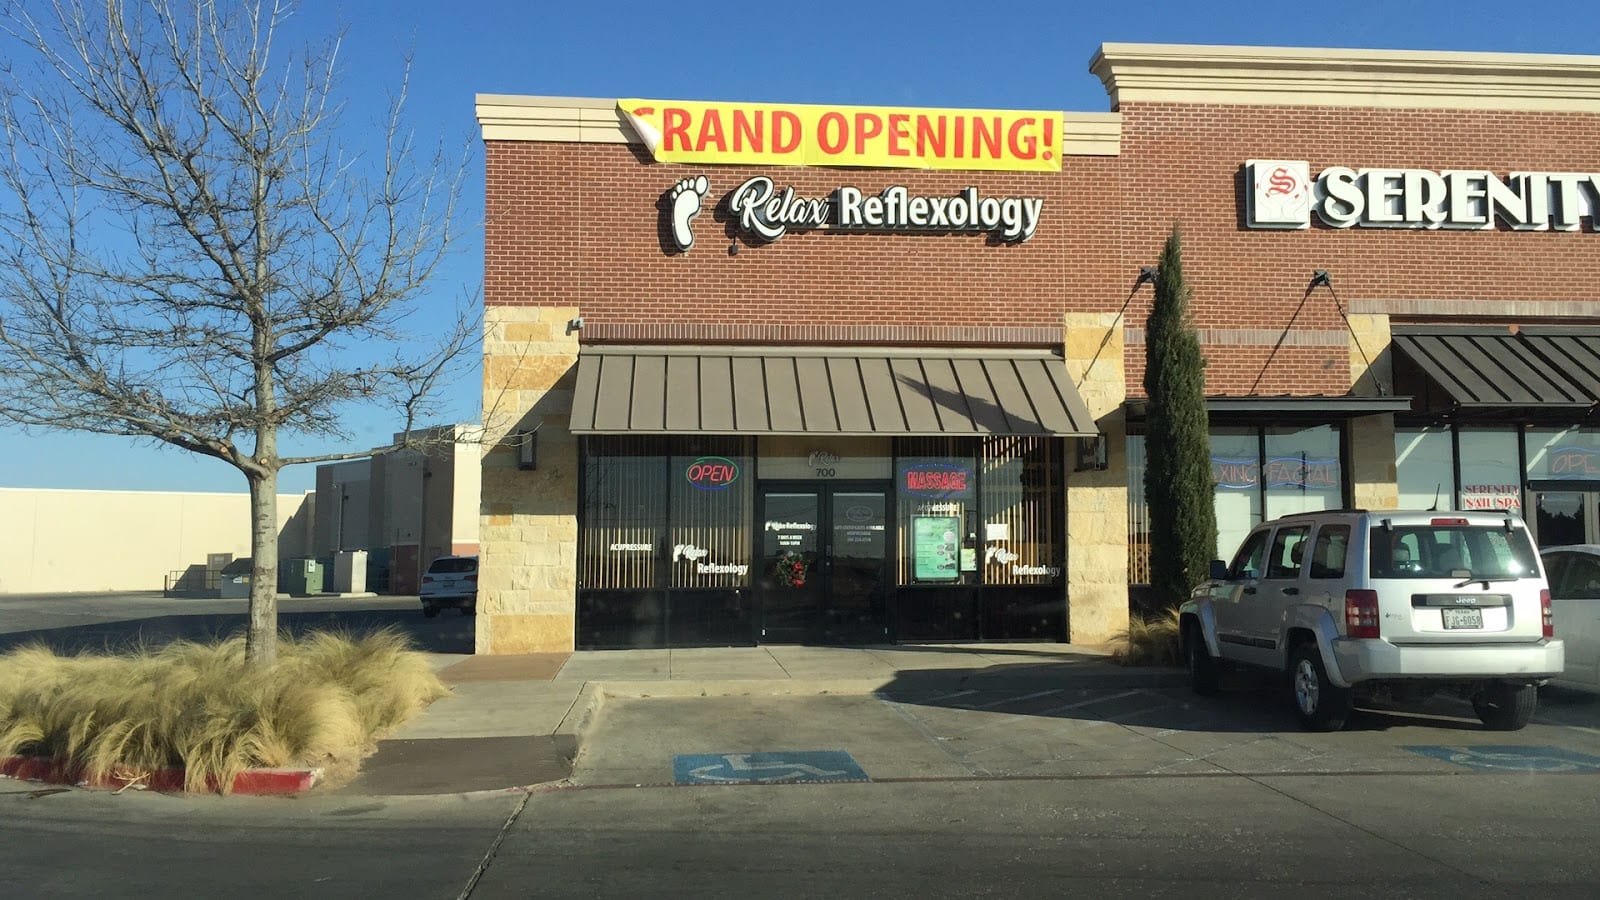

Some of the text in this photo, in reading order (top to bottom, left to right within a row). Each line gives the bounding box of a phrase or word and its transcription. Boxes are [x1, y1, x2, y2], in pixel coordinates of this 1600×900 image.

[633, 106, 1055, 161] RAND OPENING!
[731, 176, 1044, 239] Relax Reflexology
[688, 464, 735, 482] OPEN
[816, 468, 836, 477] 700
[1213, 463, 1257, 485] XING
[1269, 463, 1337, 484] FACIAL
[907, 471, 967, 490] MASSAGE
[1465, 484, 1519, 494] SERENITY
[1466, 498, 1520, 509] NAIL SPA
[610, 543, 653, 551] ACUPRESSURE
[697, 562, 749, 576] Reflexology
[1012, 564, 1061, 577] Reflexology
[1455, 596, 1476, 605] Jeep
